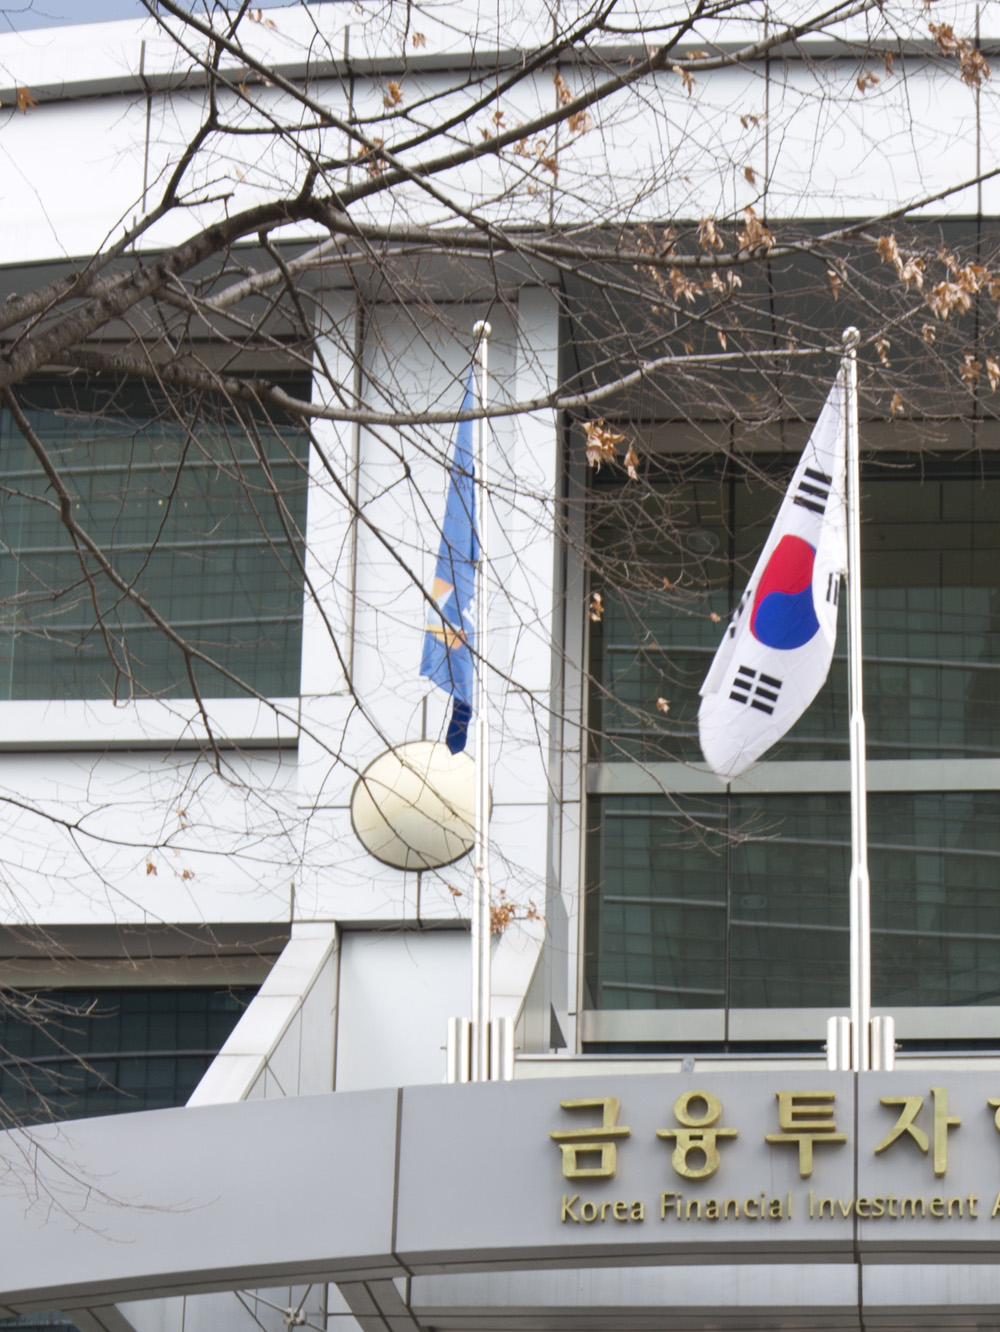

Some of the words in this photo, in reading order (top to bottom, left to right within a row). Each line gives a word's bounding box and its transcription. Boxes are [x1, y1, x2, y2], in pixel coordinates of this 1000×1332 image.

[560, 1194, 645, 1223] Korea
[660, 1191, 793, 1220] Financial
[807, 1190, 979, 1219] Investment
